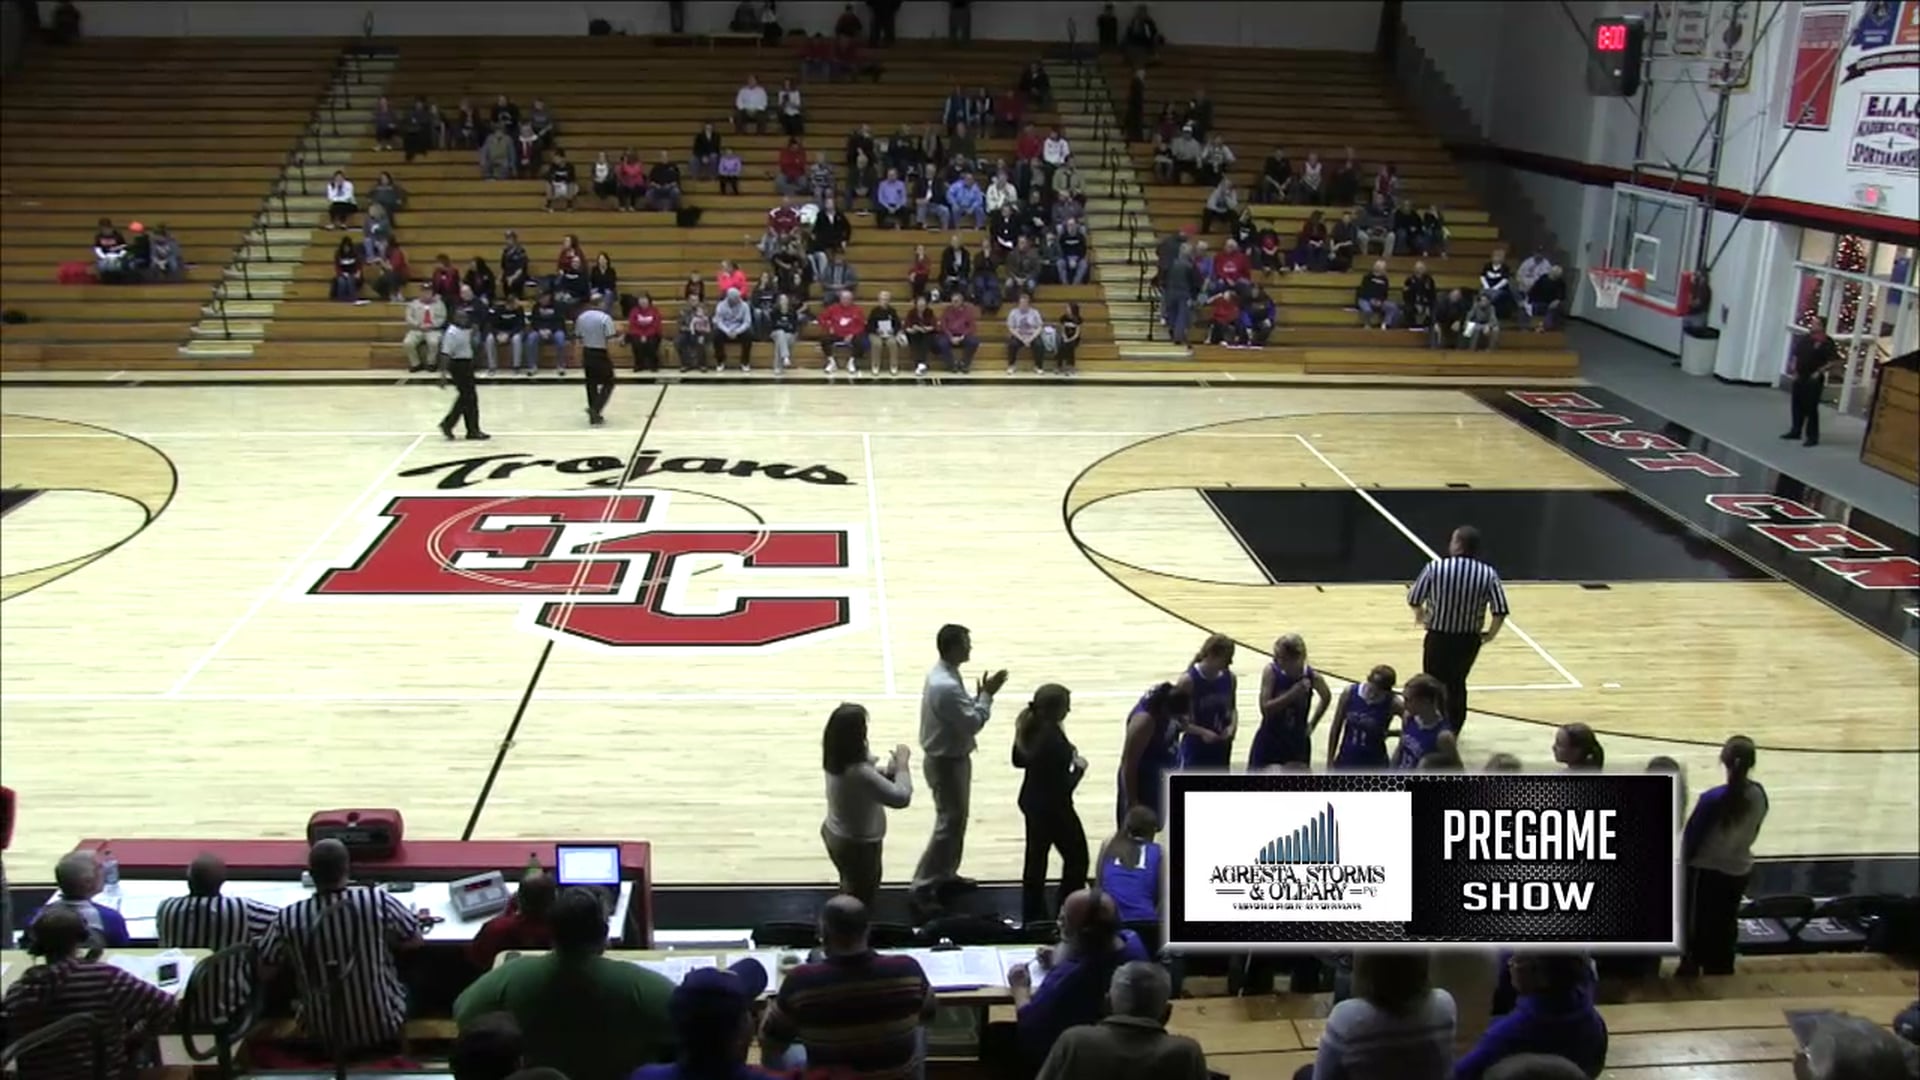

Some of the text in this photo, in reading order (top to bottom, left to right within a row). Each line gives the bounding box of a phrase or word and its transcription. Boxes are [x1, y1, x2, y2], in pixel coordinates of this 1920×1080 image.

[1598, 25, 1626, 50] 8:00
[397, 450, 858, 489] Trojans
[1505, 391, 1919, 617] EAST CEN
[305, 495, 850, 647] EC
